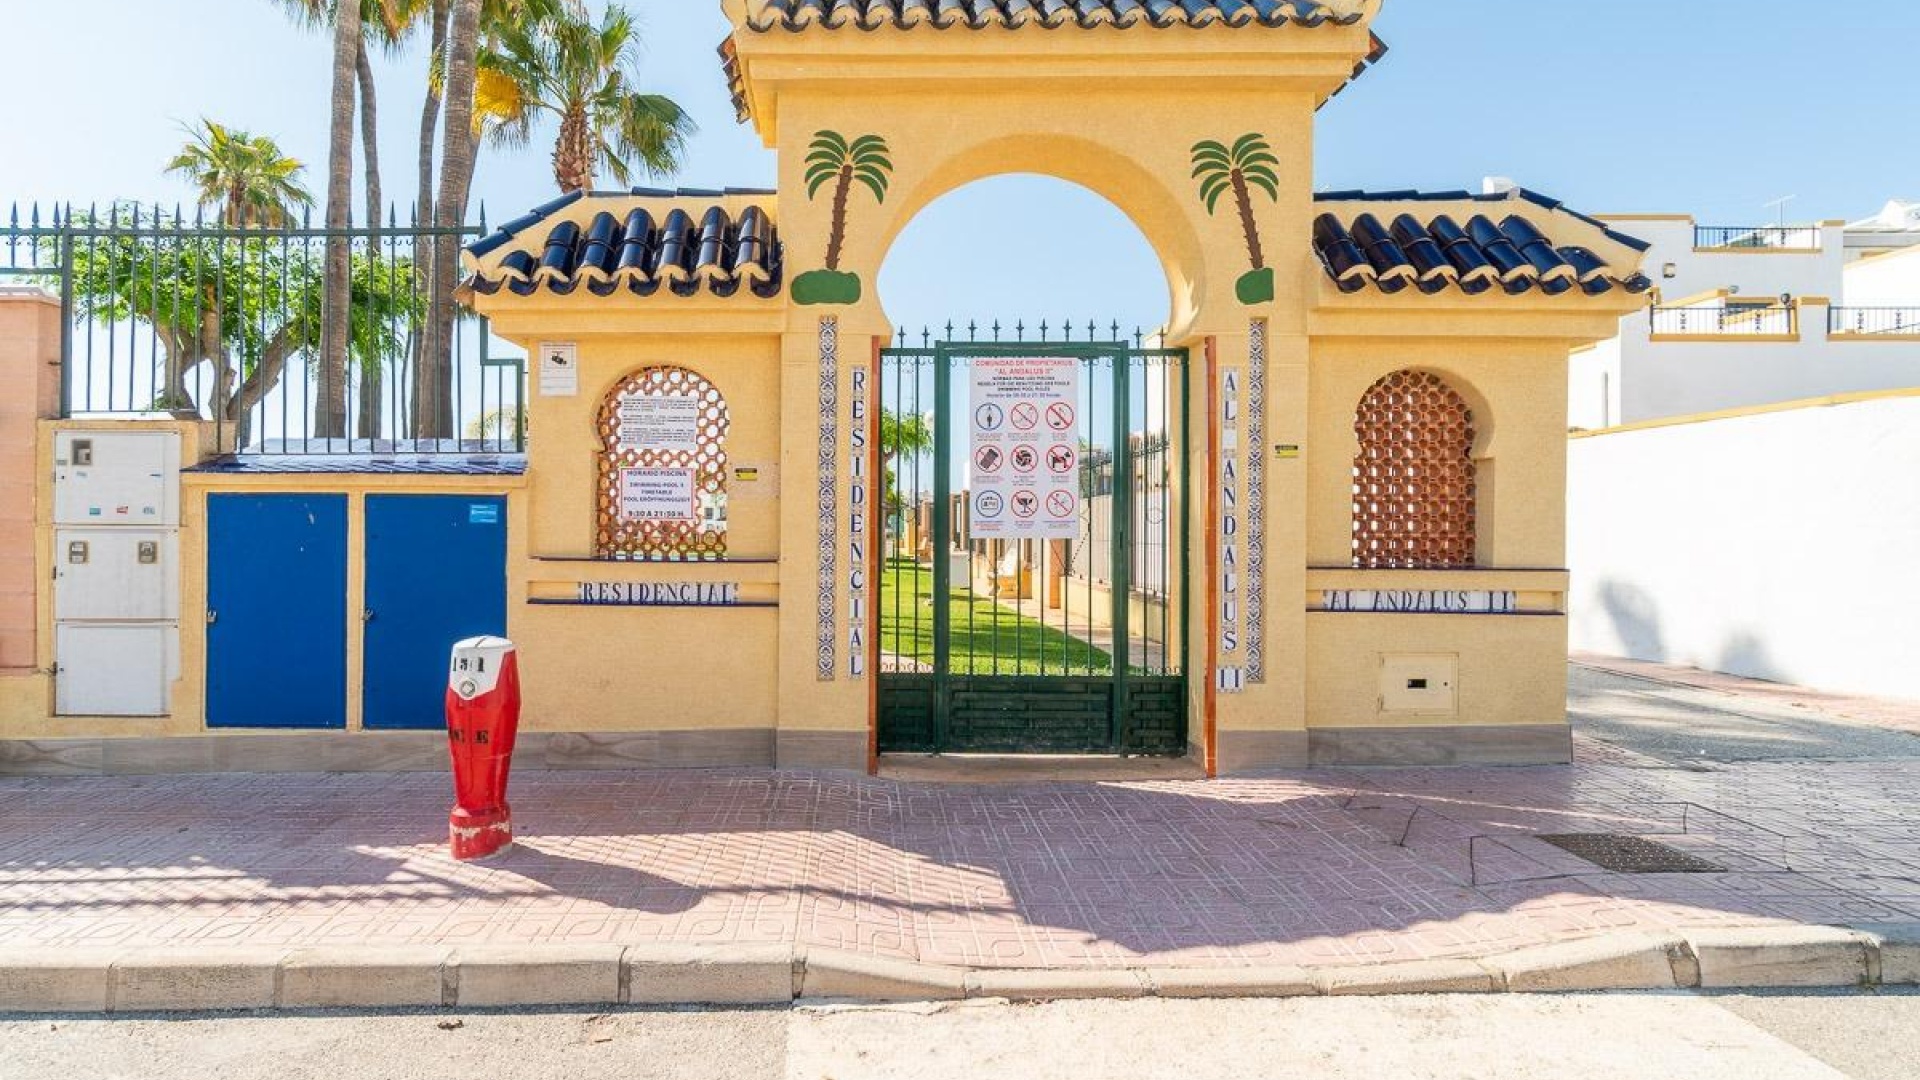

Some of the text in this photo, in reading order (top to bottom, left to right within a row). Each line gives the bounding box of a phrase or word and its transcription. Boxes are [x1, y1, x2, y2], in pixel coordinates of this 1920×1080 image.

[1223, 372, 1236, 421] AL
[850, 371, 866, 676] RESIDENCIAL
[1222, 459, 1237, 651] ANDALUS
[583, 582, 733, 604] RESIDENCIAL
[1331, 590, 1509, 613] AL ANDALUS II
